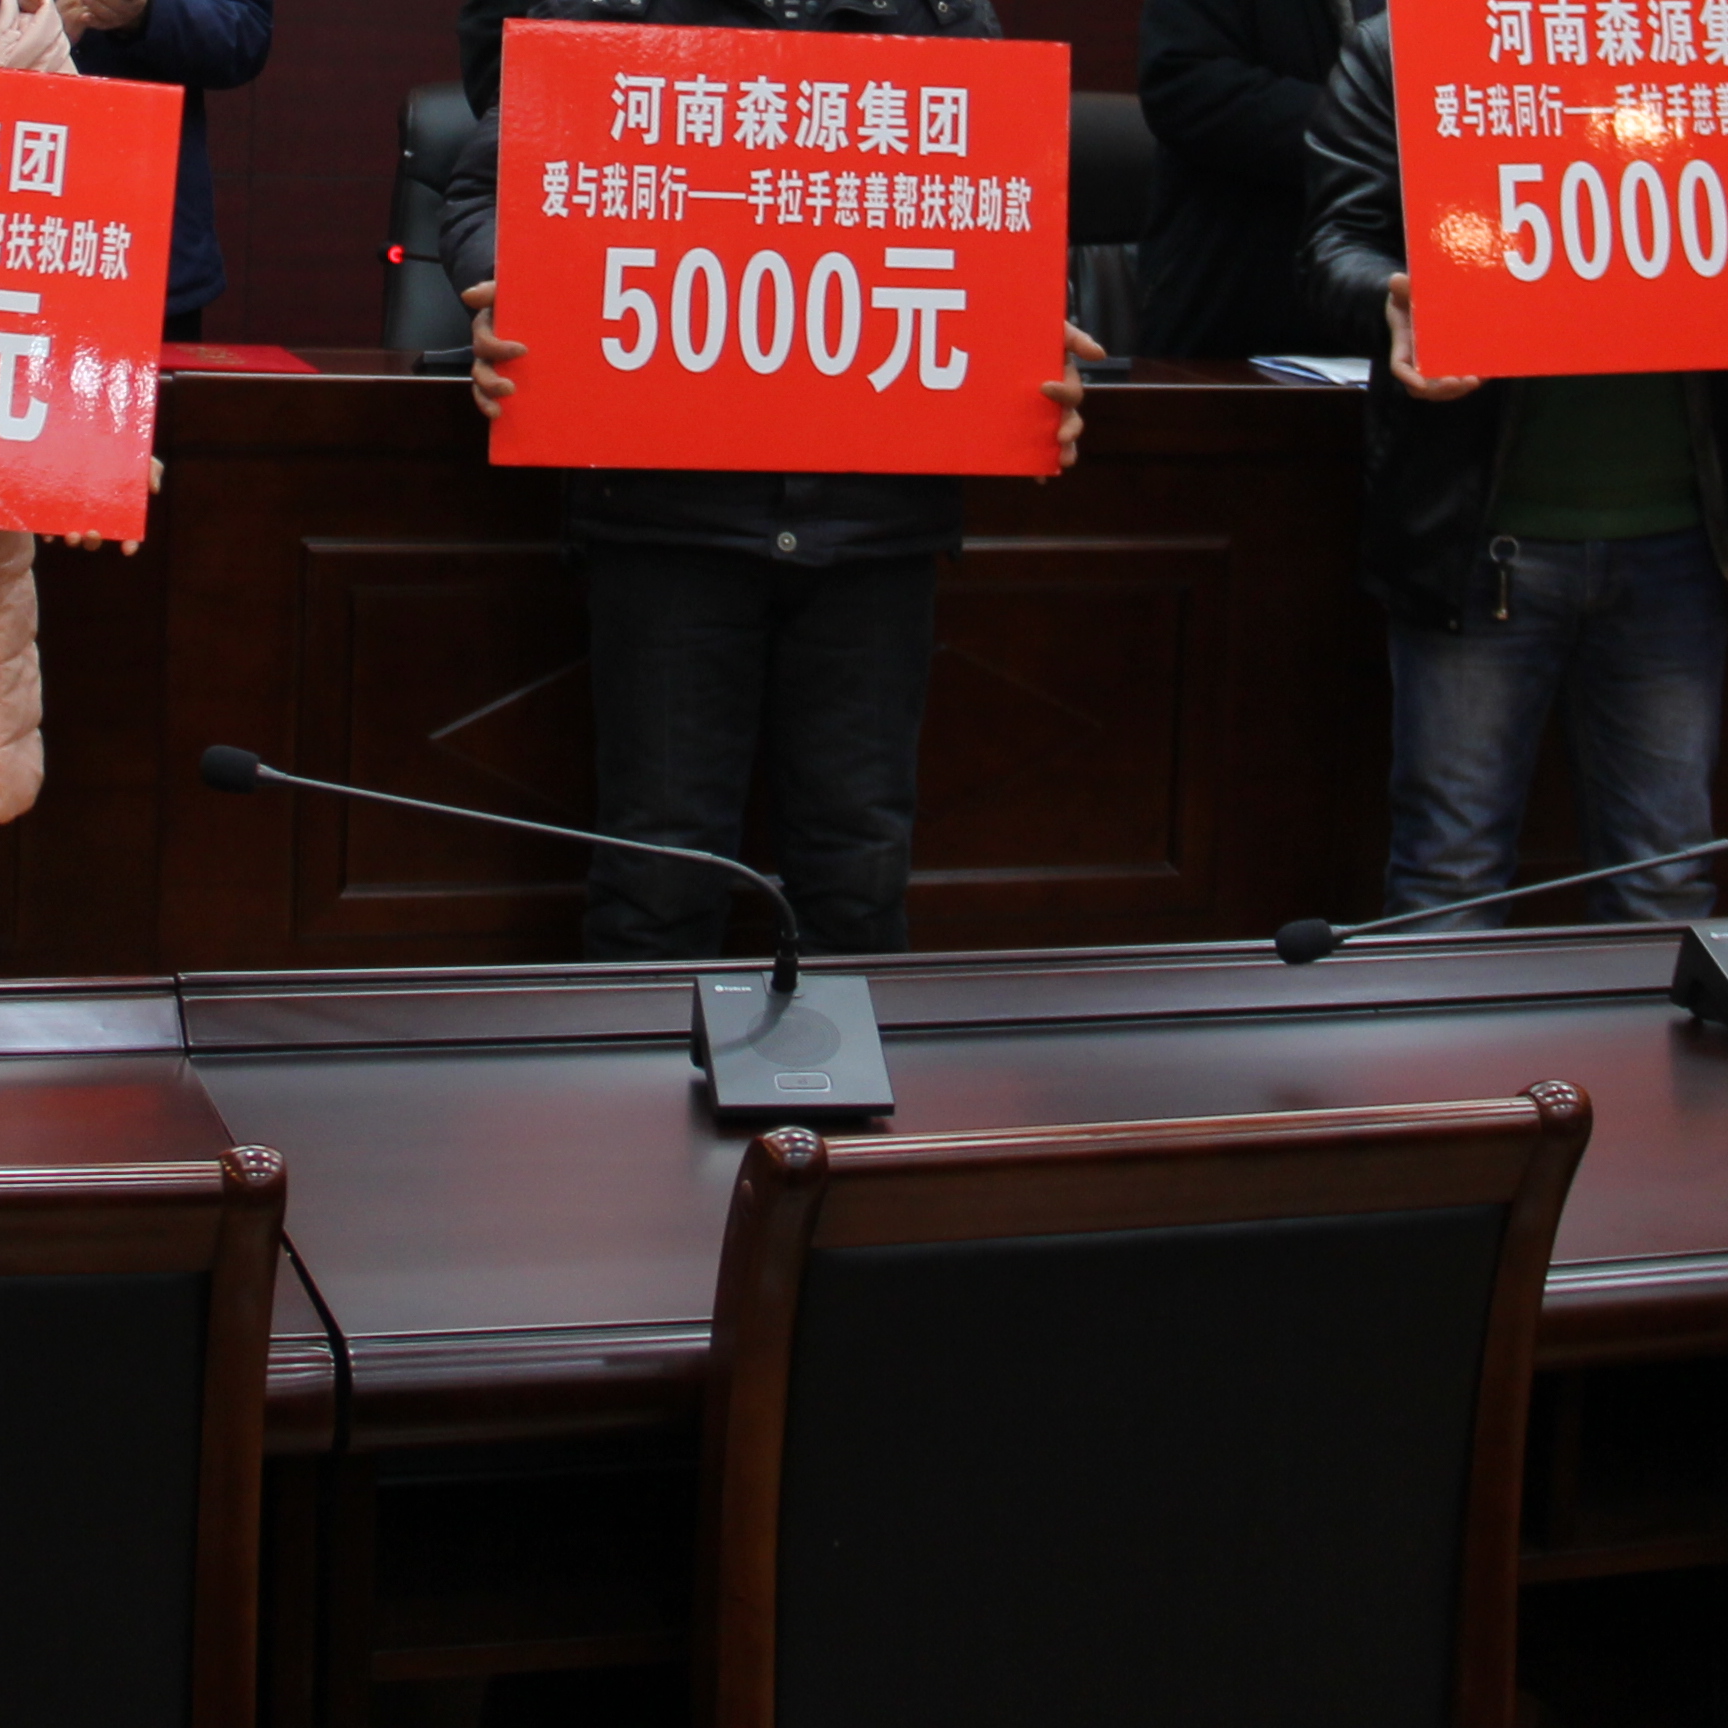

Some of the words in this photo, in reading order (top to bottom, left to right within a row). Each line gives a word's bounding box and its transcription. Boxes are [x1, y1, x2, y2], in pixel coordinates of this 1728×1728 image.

[610, 72, 969, 157] 河南森源集团
[601, 247, 969, 393] 5000元
